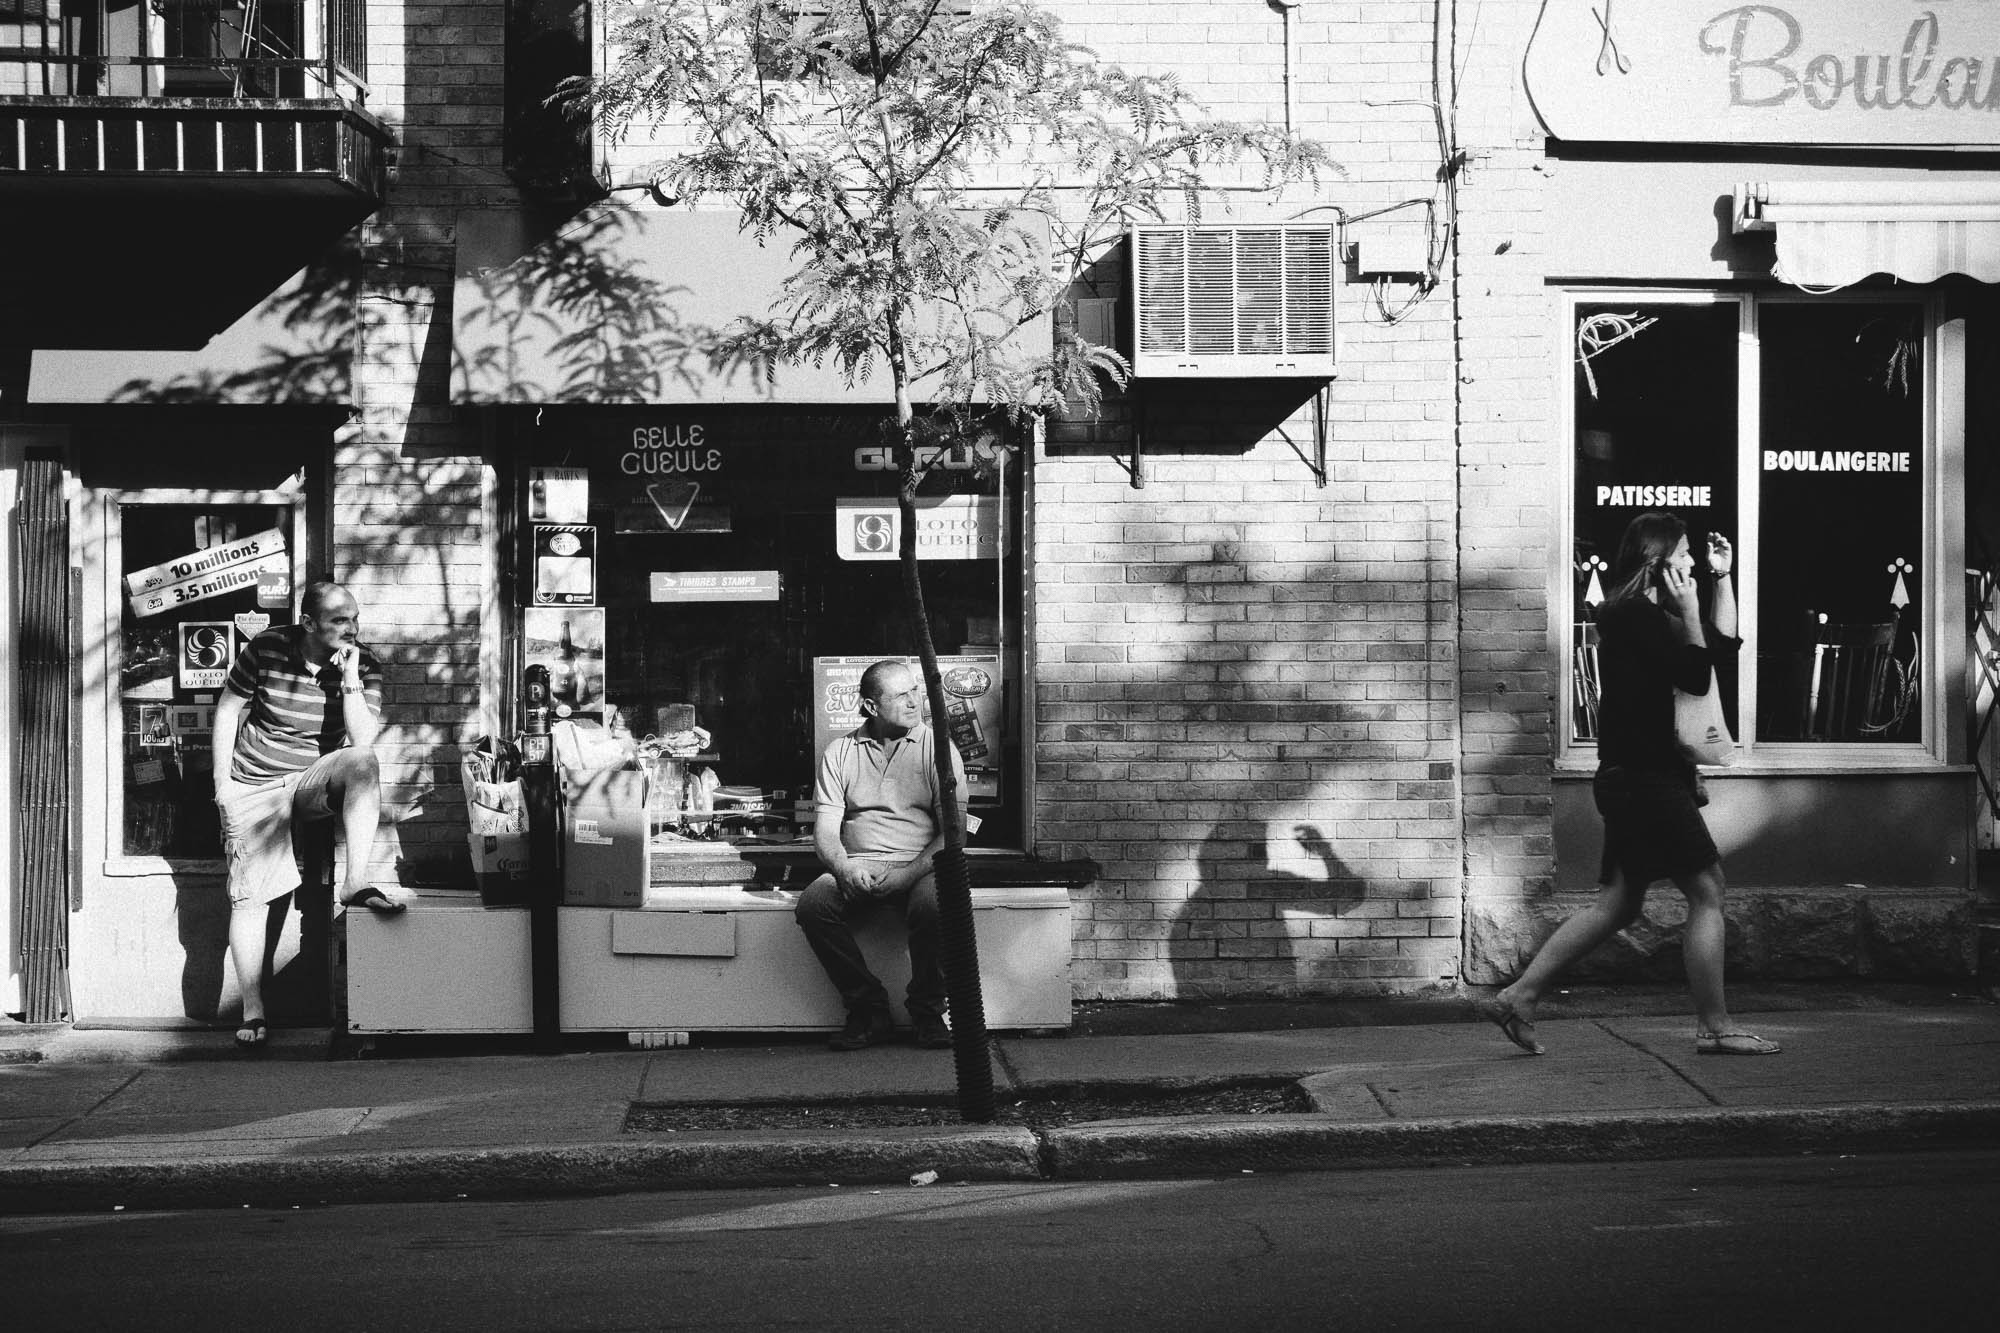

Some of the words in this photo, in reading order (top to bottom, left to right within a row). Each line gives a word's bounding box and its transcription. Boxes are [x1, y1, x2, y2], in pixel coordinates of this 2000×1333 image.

[633, 424, 705, 449] BELLE
[620, 449, 722, 475] GUEULE
[1763, 450, 1910, 472] BOULANGERIE
[1596, 485, 1711, 507] PATISSERIE
[916, 519, 978, 531] LOTO
[918, 532, 994, 545] UÉBEC
[170, 562, 192, 579] 10
[194, 541, 260, 572] million$
[680, 577, 717, 587] TIMBRES
[721, 576, 757, 586] STAMPS
[258, 585, 291, 595] GURU
[529, 738, 545, 749] PH
[528, 750, 546, 761] 517
